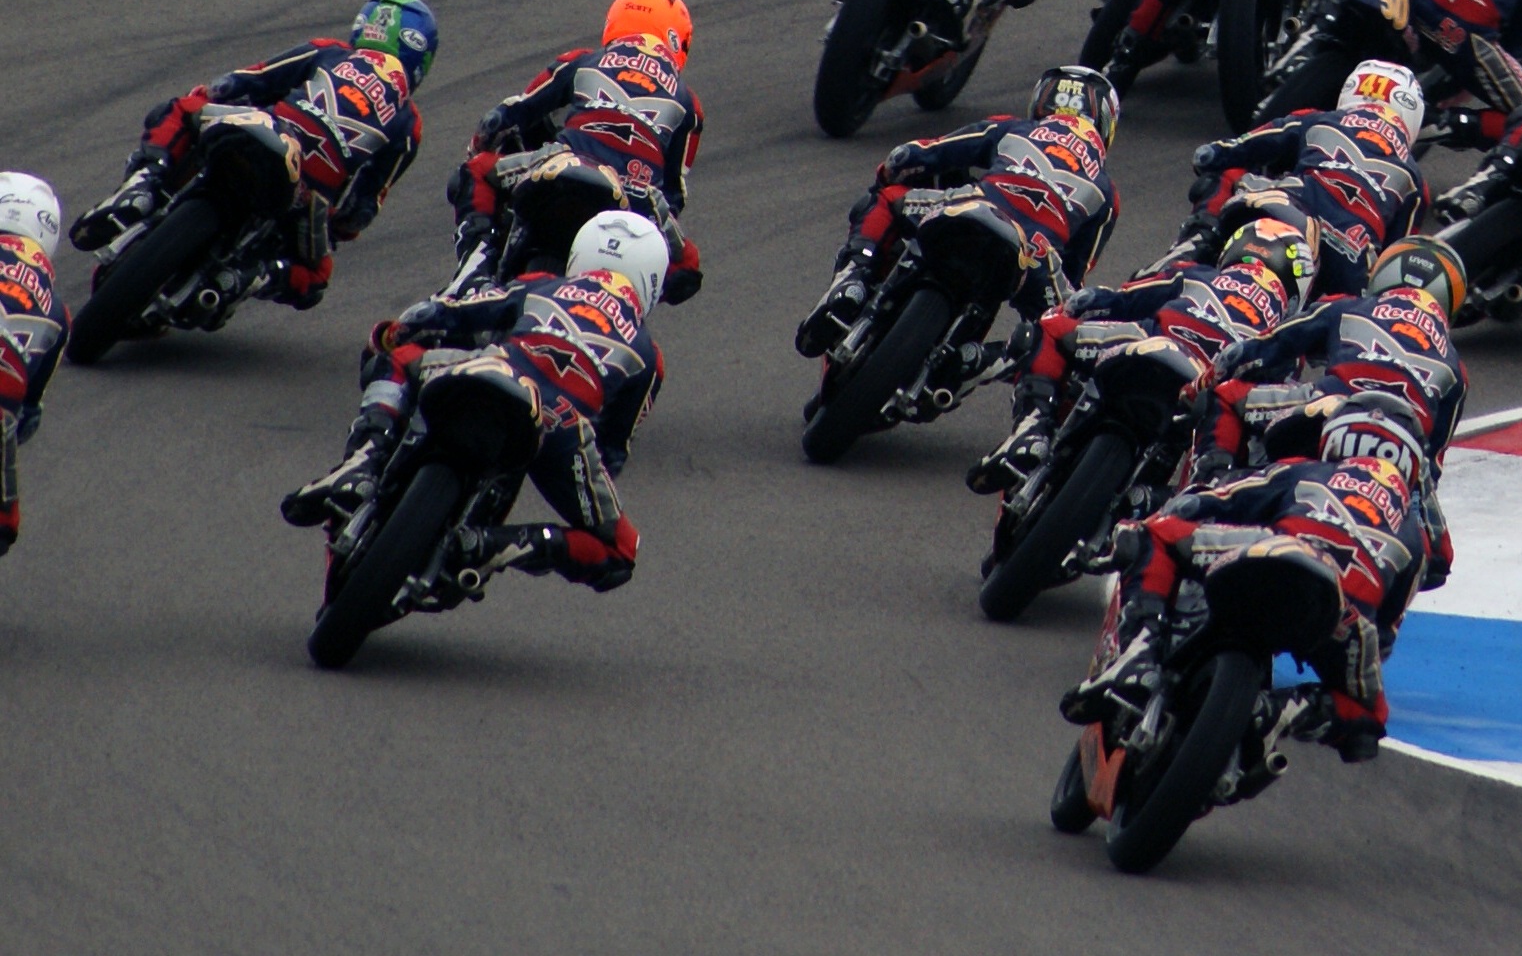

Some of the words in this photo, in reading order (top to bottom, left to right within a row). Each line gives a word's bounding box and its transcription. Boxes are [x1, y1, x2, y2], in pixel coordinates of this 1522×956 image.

[331, 62, 377, 90] Red
[365, 79, 396, 126] Bull
[598, 52, 646, 70] Red
[643, 56, 677, 97] Bull
[1358, 73, 1390, 101] 41
[1028, 126, 1076, 148] Red
[1070, 138, 1100, 181] Bull
[1340, 114, 1384, 133] Red
[1381, 124, 1408, 163] Bull
[626, 159, 654, 184] 95
[1211, 275, 1259, 299] Red
[1408, 255, 1435, 271] uvex
[21, 267, 52, 317] Bull
[552, 284, 608, 308] Red
[600, 294, 637, 344] Bull
[1372, 303, 1421, 324] Red
[1418, 313, 1448, 358] Bull
[553, 395, 580, 429] 77
[1327, 472, 1377, 498] Red
[1372, 485, 1403, 534] Bull
